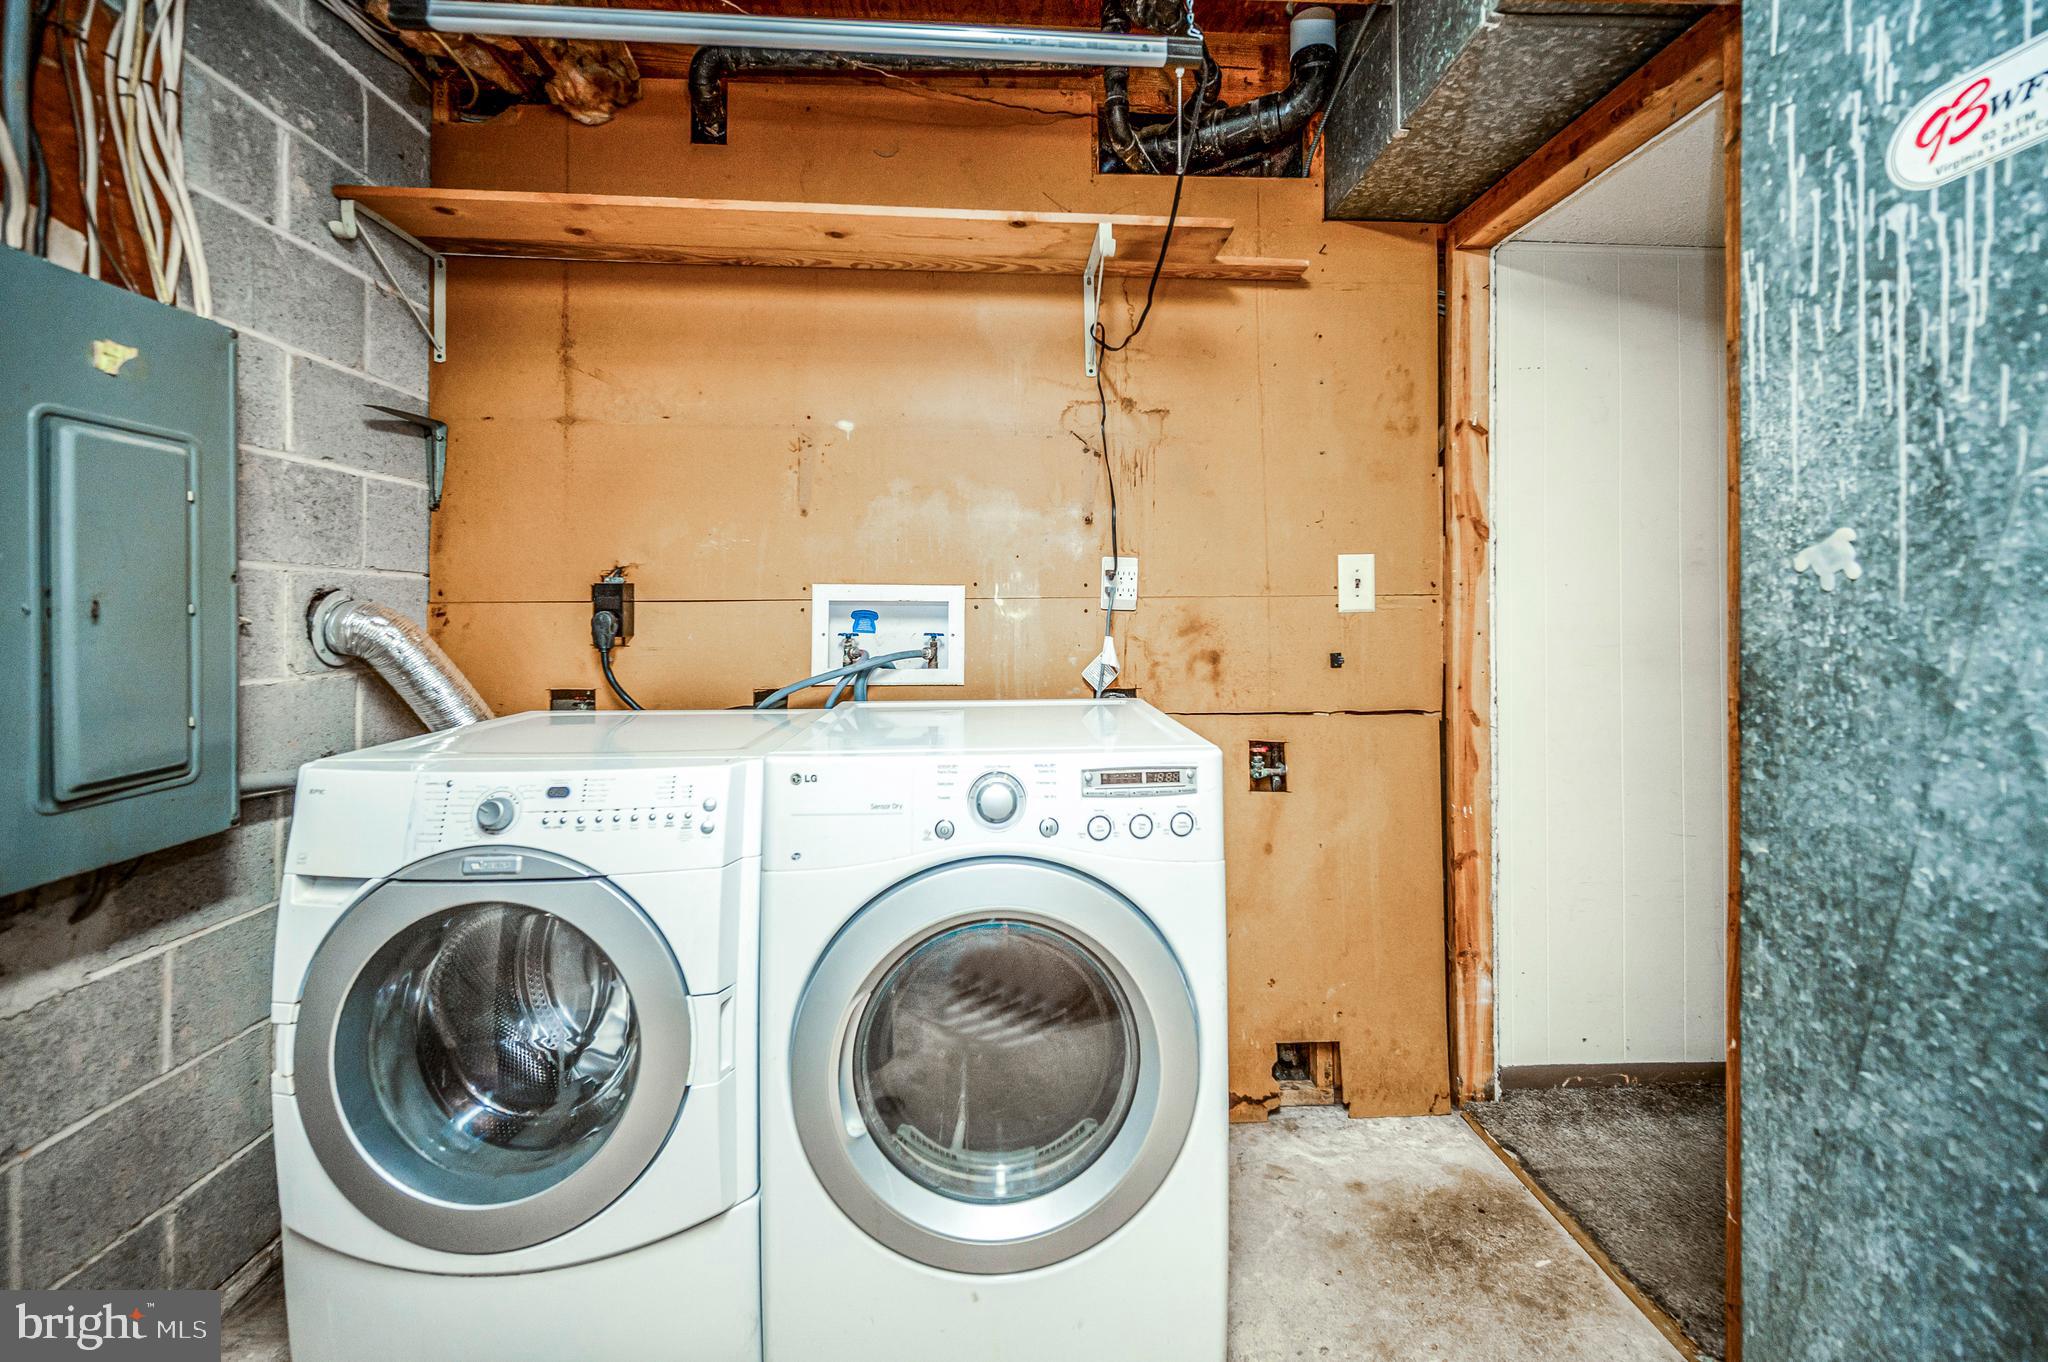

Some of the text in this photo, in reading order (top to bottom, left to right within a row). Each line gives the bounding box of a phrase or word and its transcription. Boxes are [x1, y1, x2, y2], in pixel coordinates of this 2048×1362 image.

[1915, 77, 1991, 165] 93
[1935, 145, 1996, 175] Virginias
[804, 775, 818, 783] LG
